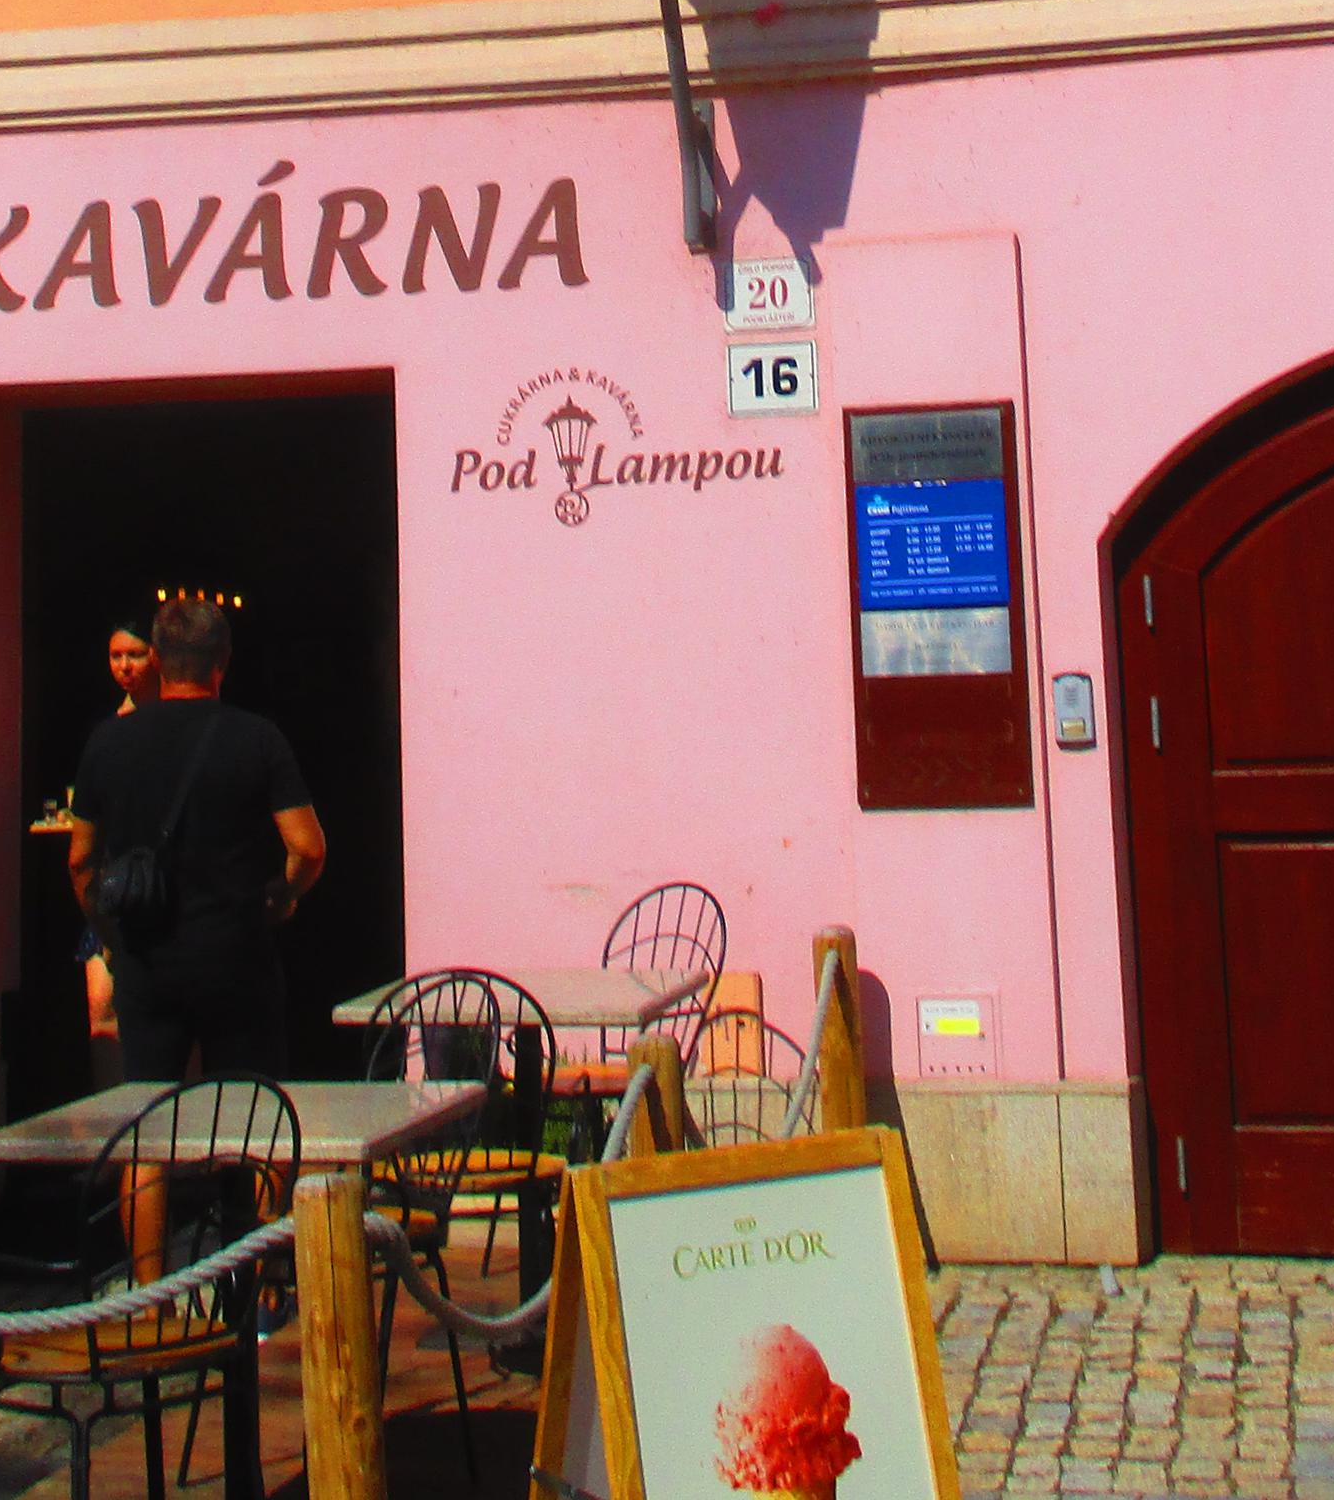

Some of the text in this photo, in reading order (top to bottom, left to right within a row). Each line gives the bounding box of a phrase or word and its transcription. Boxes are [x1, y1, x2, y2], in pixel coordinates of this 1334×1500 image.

[748, 274, 789, 311] 20
[741, 356, 799, 399] 16
[450, 442, 785, 494] Pod Lampou
[672, 1241, 754, 1280] CARTE
